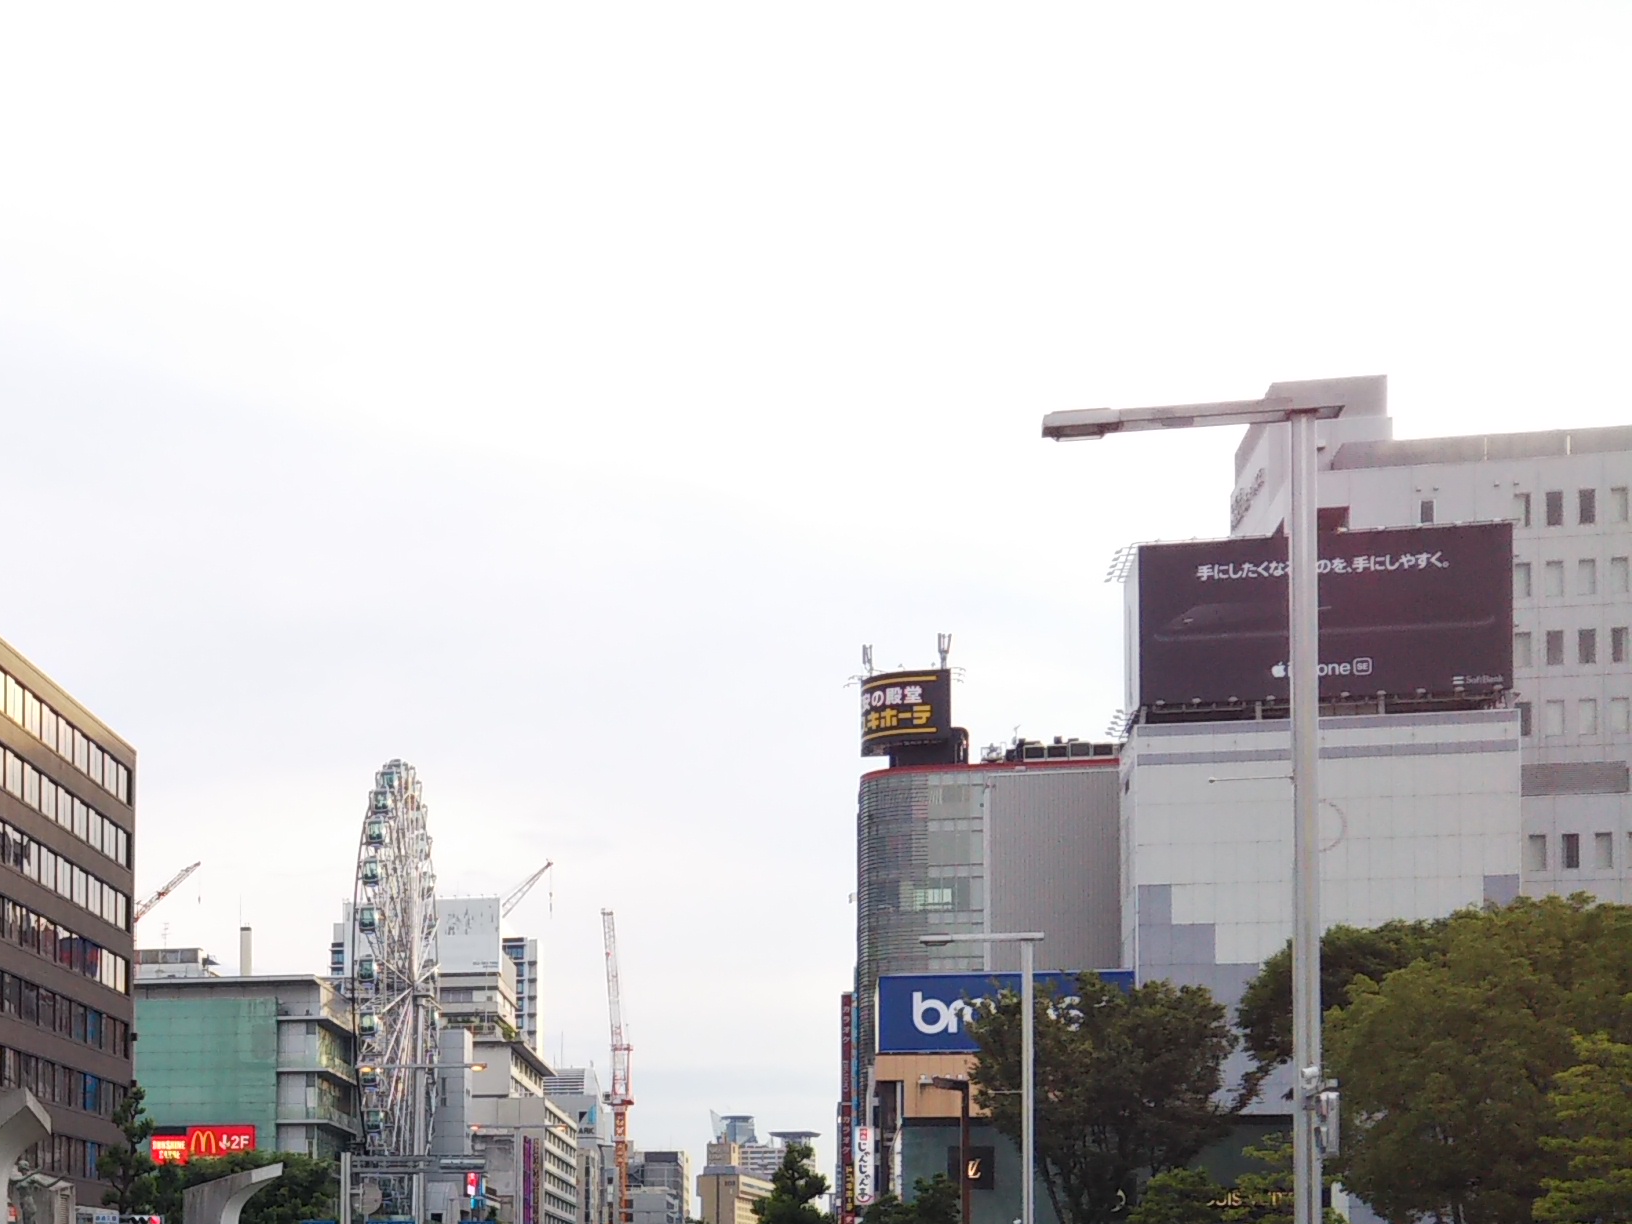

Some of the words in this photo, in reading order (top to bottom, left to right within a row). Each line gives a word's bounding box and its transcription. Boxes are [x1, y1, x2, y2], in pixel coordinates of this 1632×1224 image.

[1196, 551, 1450, 581] 手にしたくなのを、手にしやすく。
